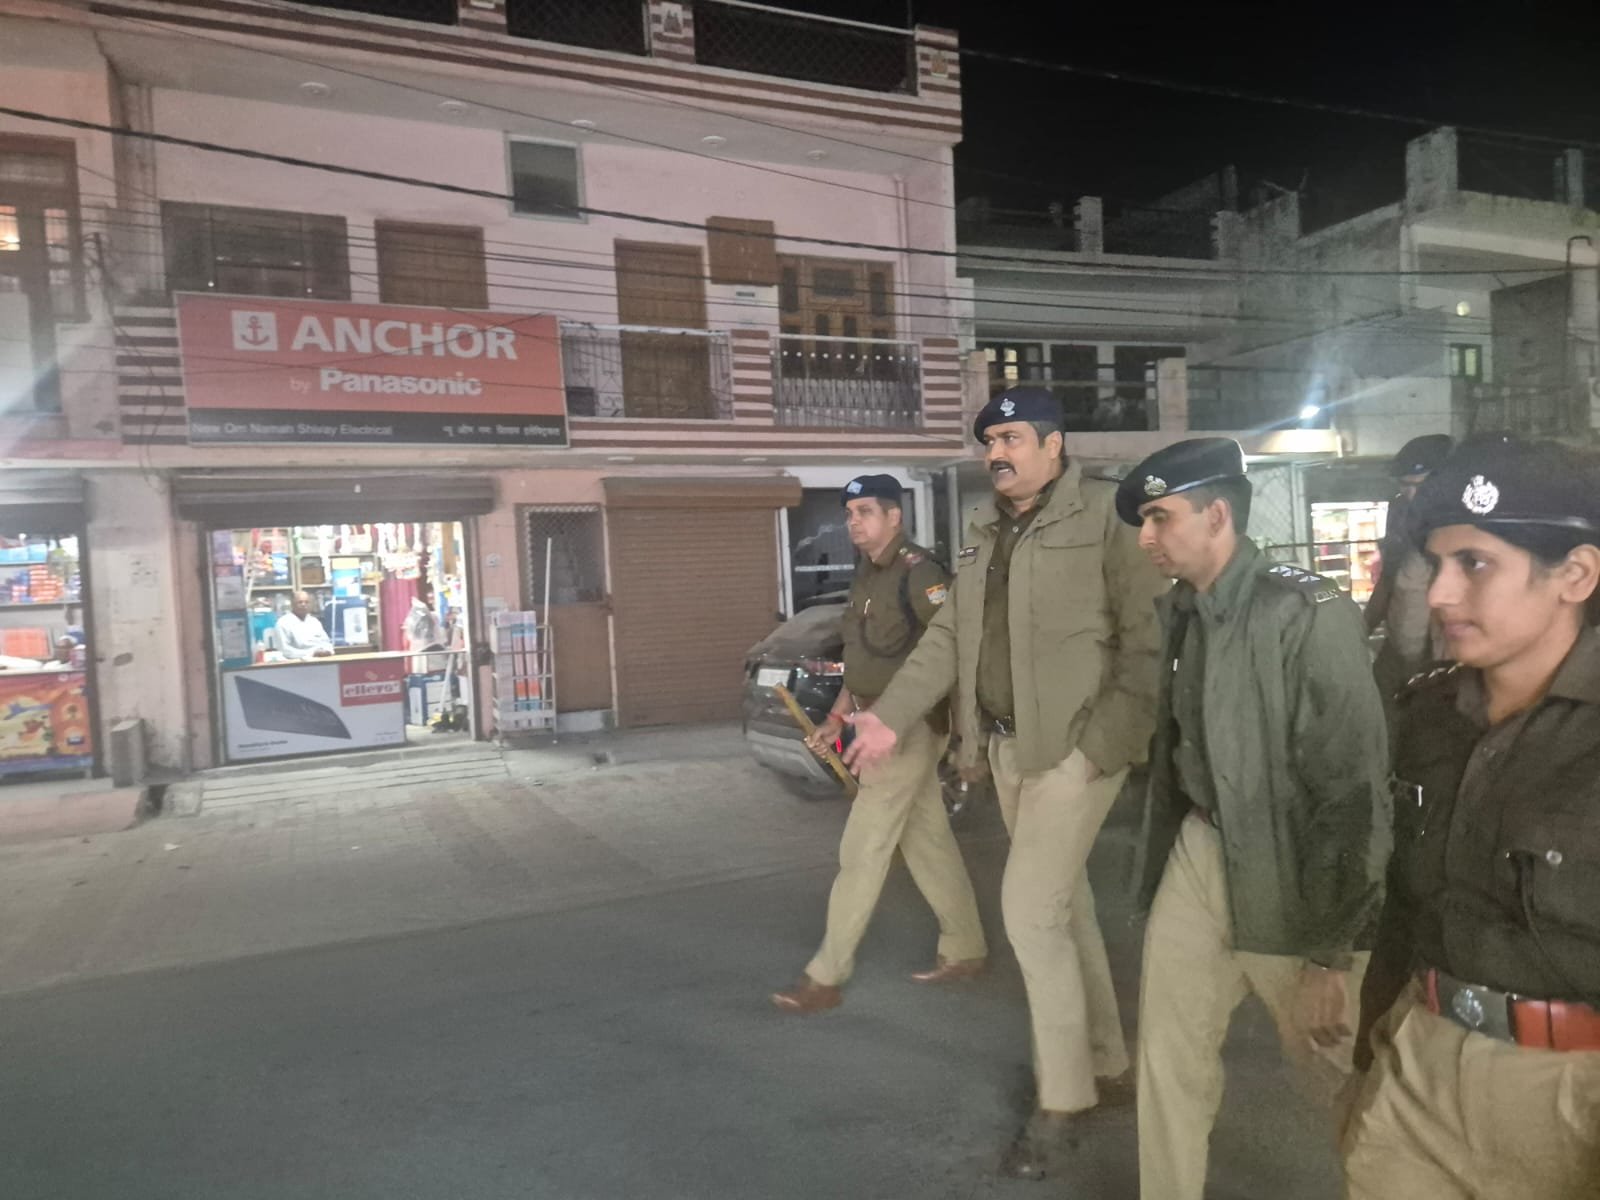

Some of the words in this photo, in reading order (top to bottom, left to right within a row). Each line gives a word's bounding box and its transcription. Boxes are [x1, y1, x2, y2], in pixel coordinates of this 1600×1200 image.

[291, 315, 518, 360] ANCHOR
[290, 377, 312, 394] by
[320, 367, 482, 395] Panasonic
